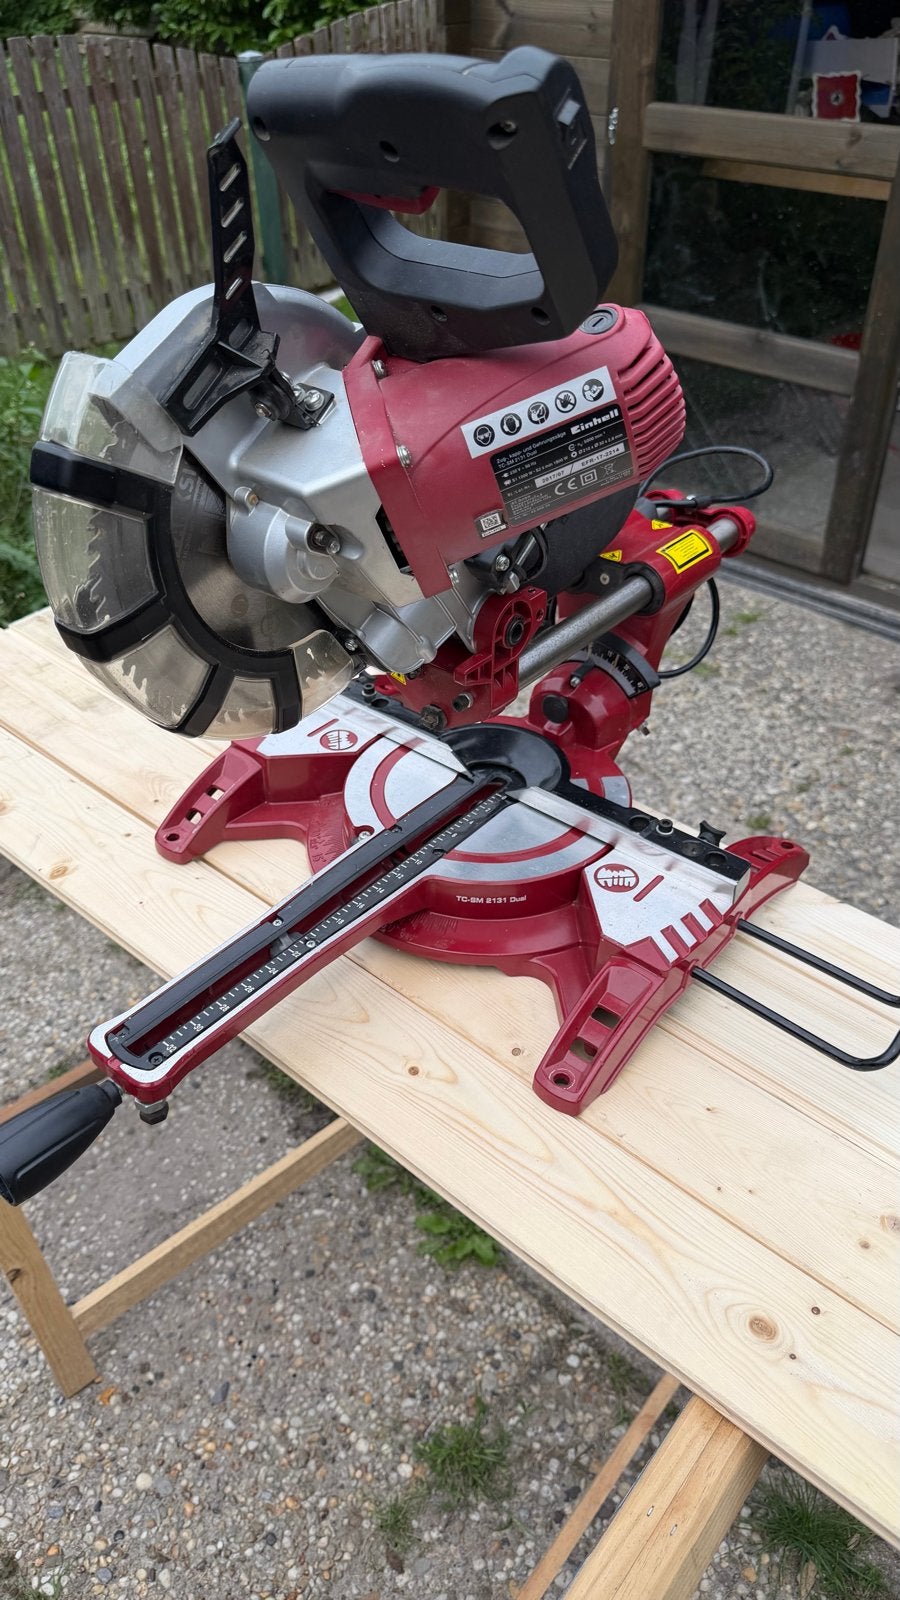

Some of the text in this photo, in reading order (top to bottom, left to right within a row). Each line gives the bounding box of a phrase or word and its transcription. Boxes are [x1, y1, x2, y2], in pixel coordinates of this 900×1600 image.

[570, 408, 619, 434] Einhell
[542, 470, 565, 483] 2017/07
[456, 895, 484, 904] TC-SM
[509, 895, 527, 903] Dual
